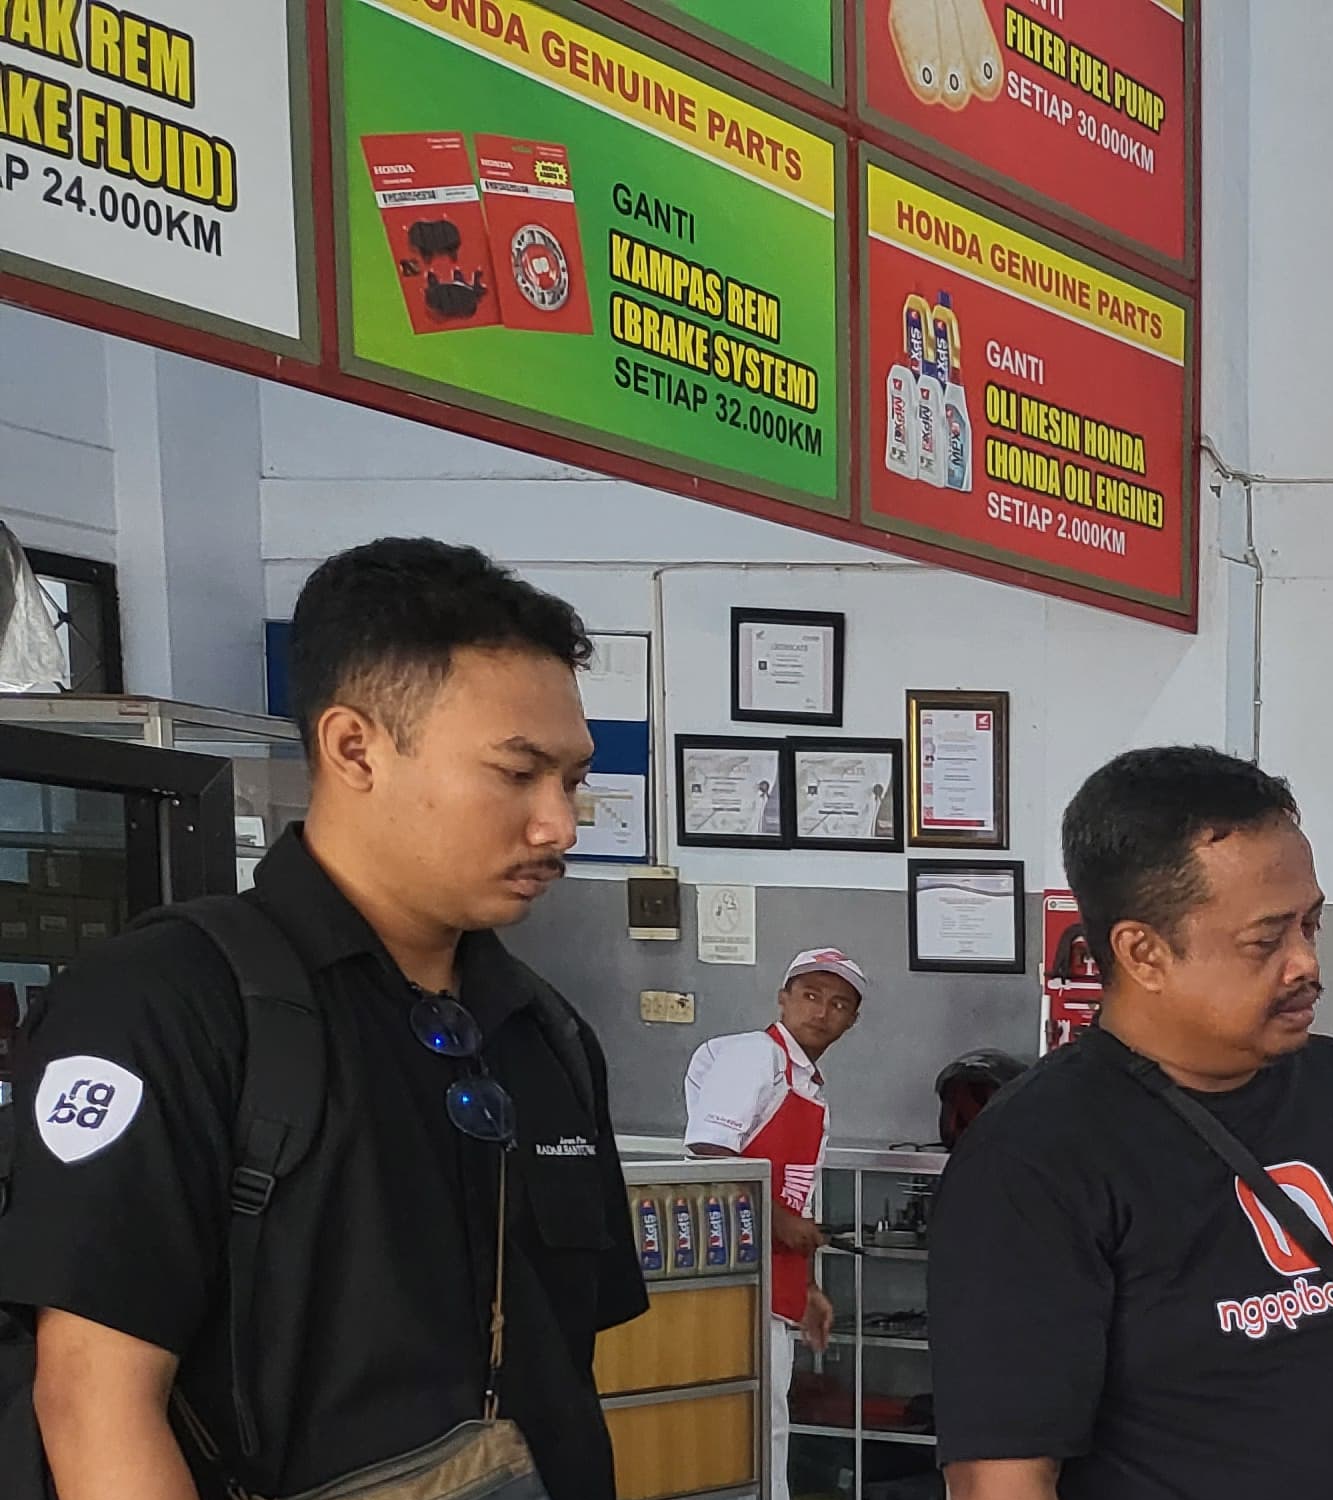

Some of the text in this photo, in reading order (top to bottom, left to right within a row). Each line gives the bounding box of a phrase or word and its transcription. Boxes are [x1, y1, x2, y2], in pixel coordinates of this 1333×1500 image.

[0, 0, 195, 108] AK REM
[541, 30, 697, 133] GENUINE
[708, 108, 802, 181] PARTS
[1005, 6, 1166, 135] FILTER FUEL PUMP
[78, 90, 237, 212] FLUID)
[1007, 70, 1155, 175] SETIAP 30.000KM
[0, 152, 222, 256] P 24.000KM
[612, 183, 695, 243] GANTI
[609, 228, 780, 344] KAMPAS REM
[897, 200, 1163, 339] HONDA GENUINE PARTS
[610, 291, 818, 414] (BRAKE SYSTEM)
[986, 340, 1044, 384] GANTI
[614, 357, 822, 457] SETIAP 32.000KM
[985, 381, 1146, 476] OLI MESIN HONDA
[985, 436, 1164, 530] (HONDA OIL ENGINE)
[987, 492, 1126, 556] SETIAP 2.000KM
